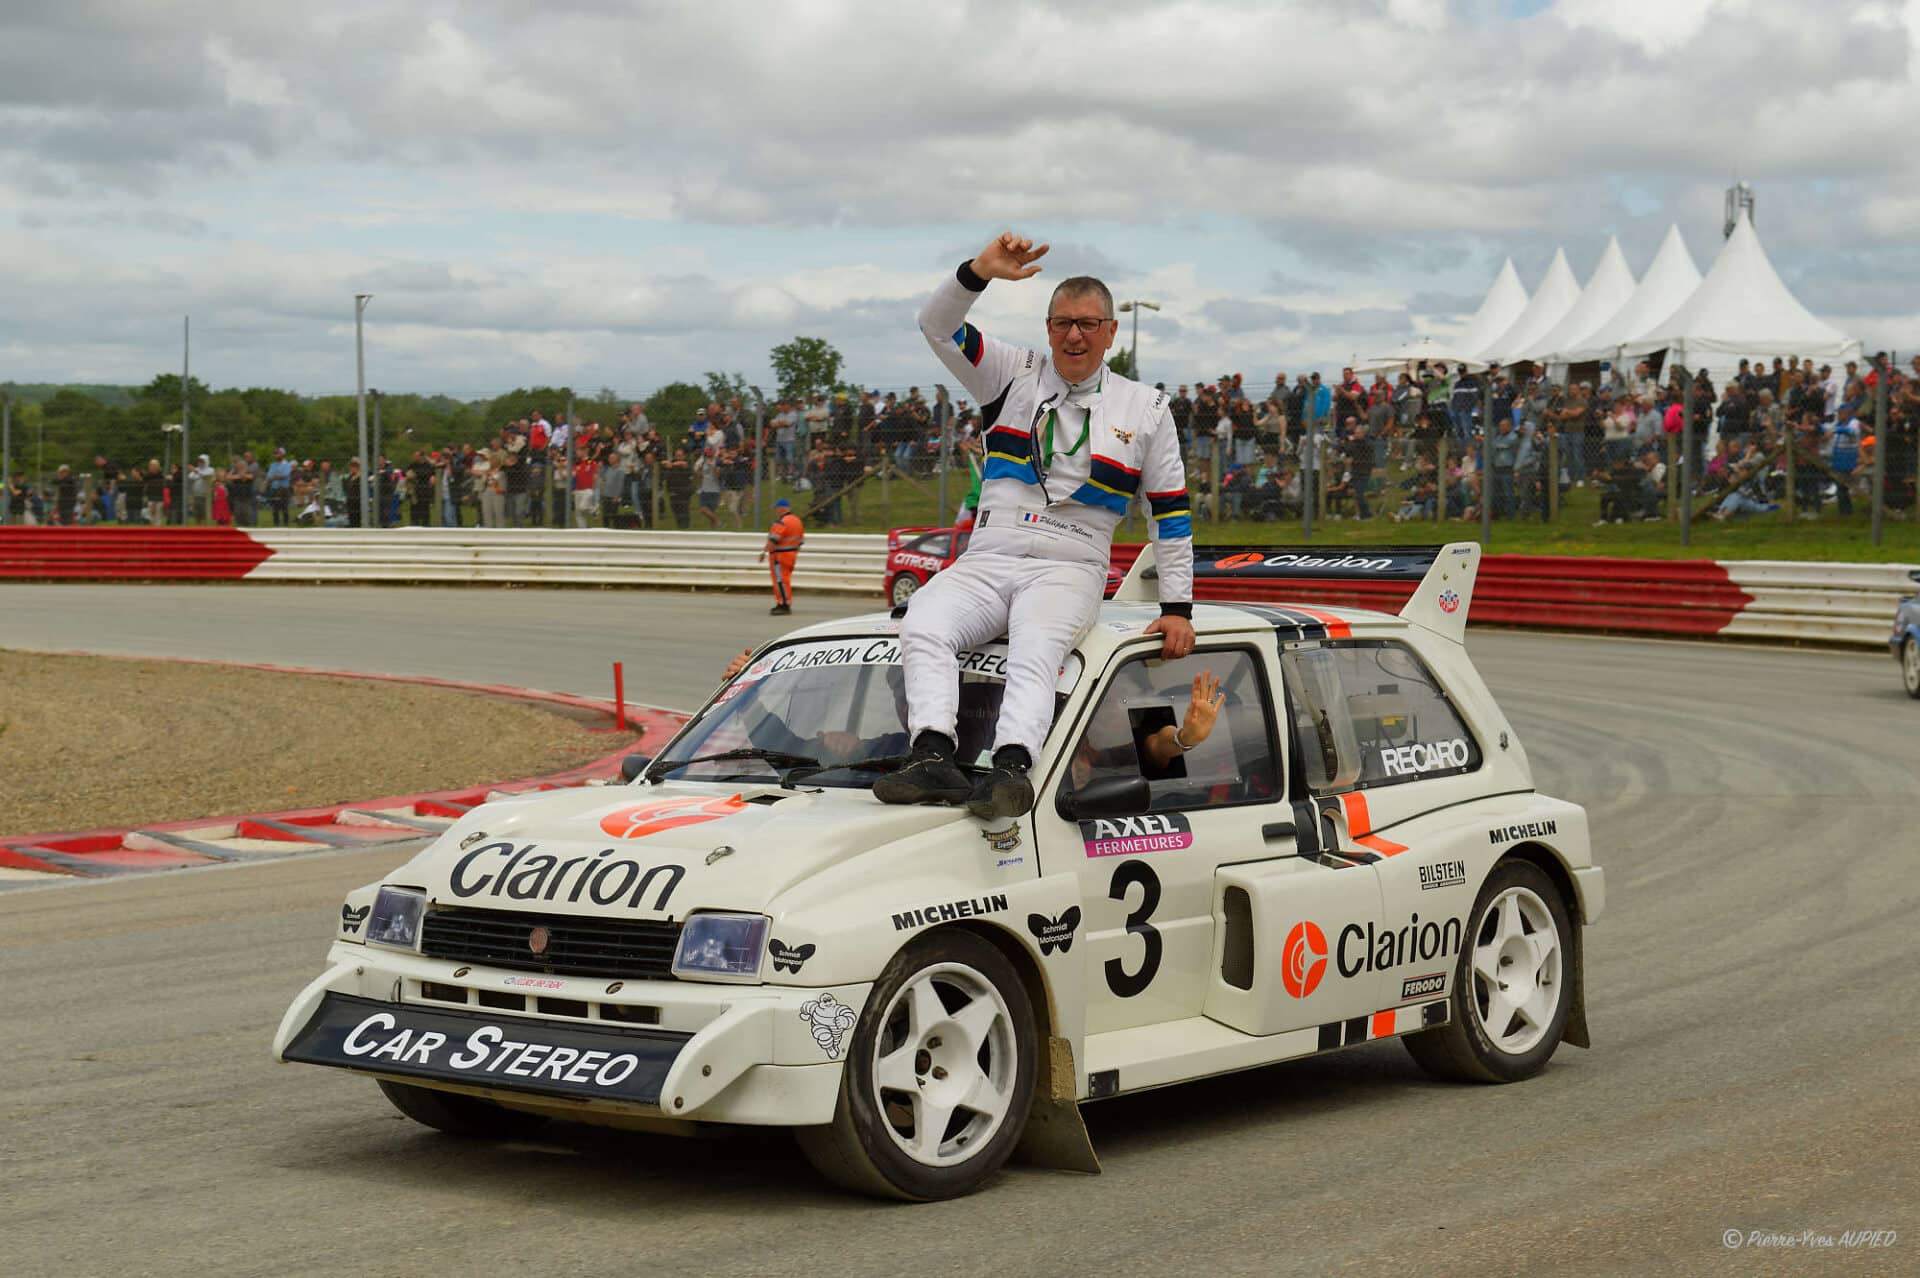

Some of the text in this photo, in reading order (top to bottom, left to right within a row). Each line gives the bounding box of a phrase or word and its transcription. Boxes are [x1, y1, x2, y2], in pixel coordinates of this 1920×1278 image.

[1264, 555, 1392, 570] Clarion
[770, 647, 860, 673] CLARION
[862, 640, 902, 663] CA
[1381, 738, 1471, 777] RECARO
[1095, 814, 1180, 840] AXEL
[1489, 820, 1557, 844] MICHELIN
[1096, 835, 1184, 855] FERMETURES
[449, 842, 687, 911] Clarion
[1419, 860, 1465, 883] BILSTEIN
[892, 894, 1009, 931] MICHELIN
[1040, 932, 1073, 945] Motorsport
[1043, 923, 1068, 935] Schmidt
[1104, 859, 1162, 998] 3
[1336, 913, 1461, 978] Clarion
[1404, 977, 1443, 996] FERODO
[343, 1012, 639, 1086] CAR STEREO
